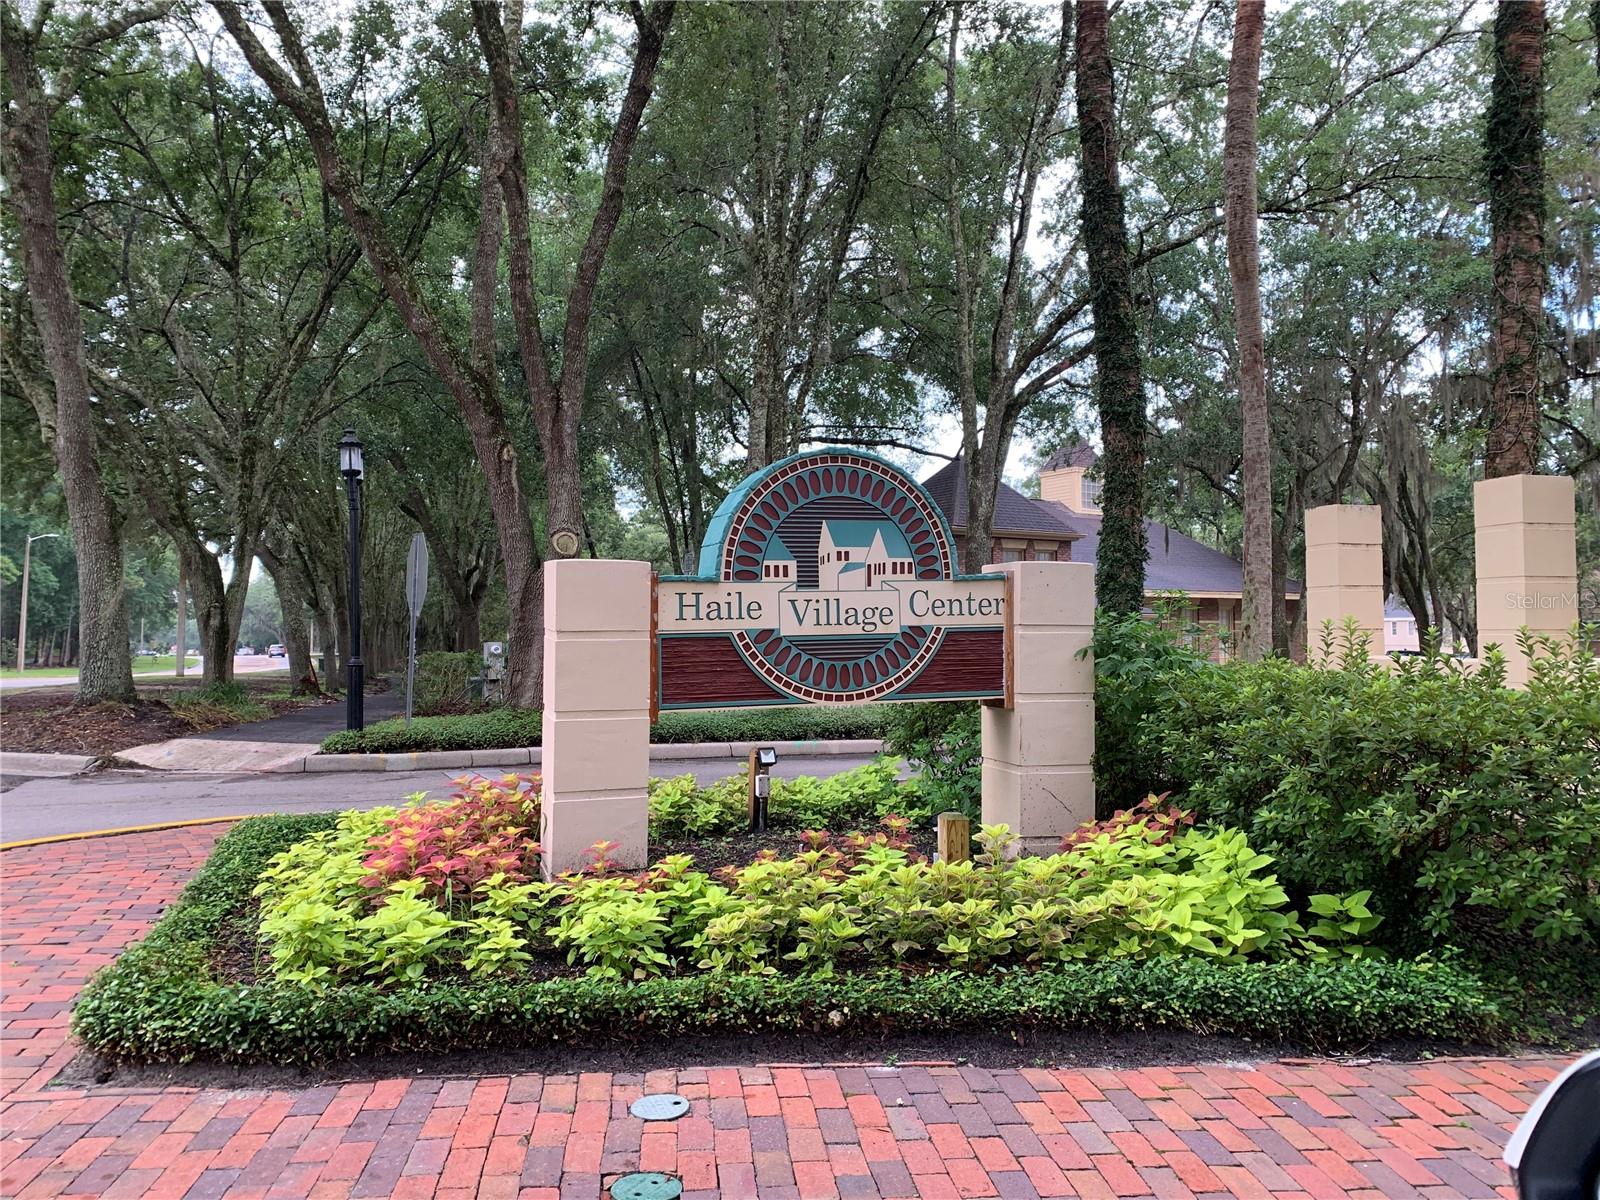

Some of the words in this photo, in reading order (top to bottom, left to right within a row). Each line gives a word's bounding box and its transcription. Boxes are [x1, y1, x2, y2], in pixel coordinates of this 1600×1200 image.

[674, 592, 763, 621] Haile
[787, 598, 894, 632] Village
[908, 589, 1005, 617] Center
